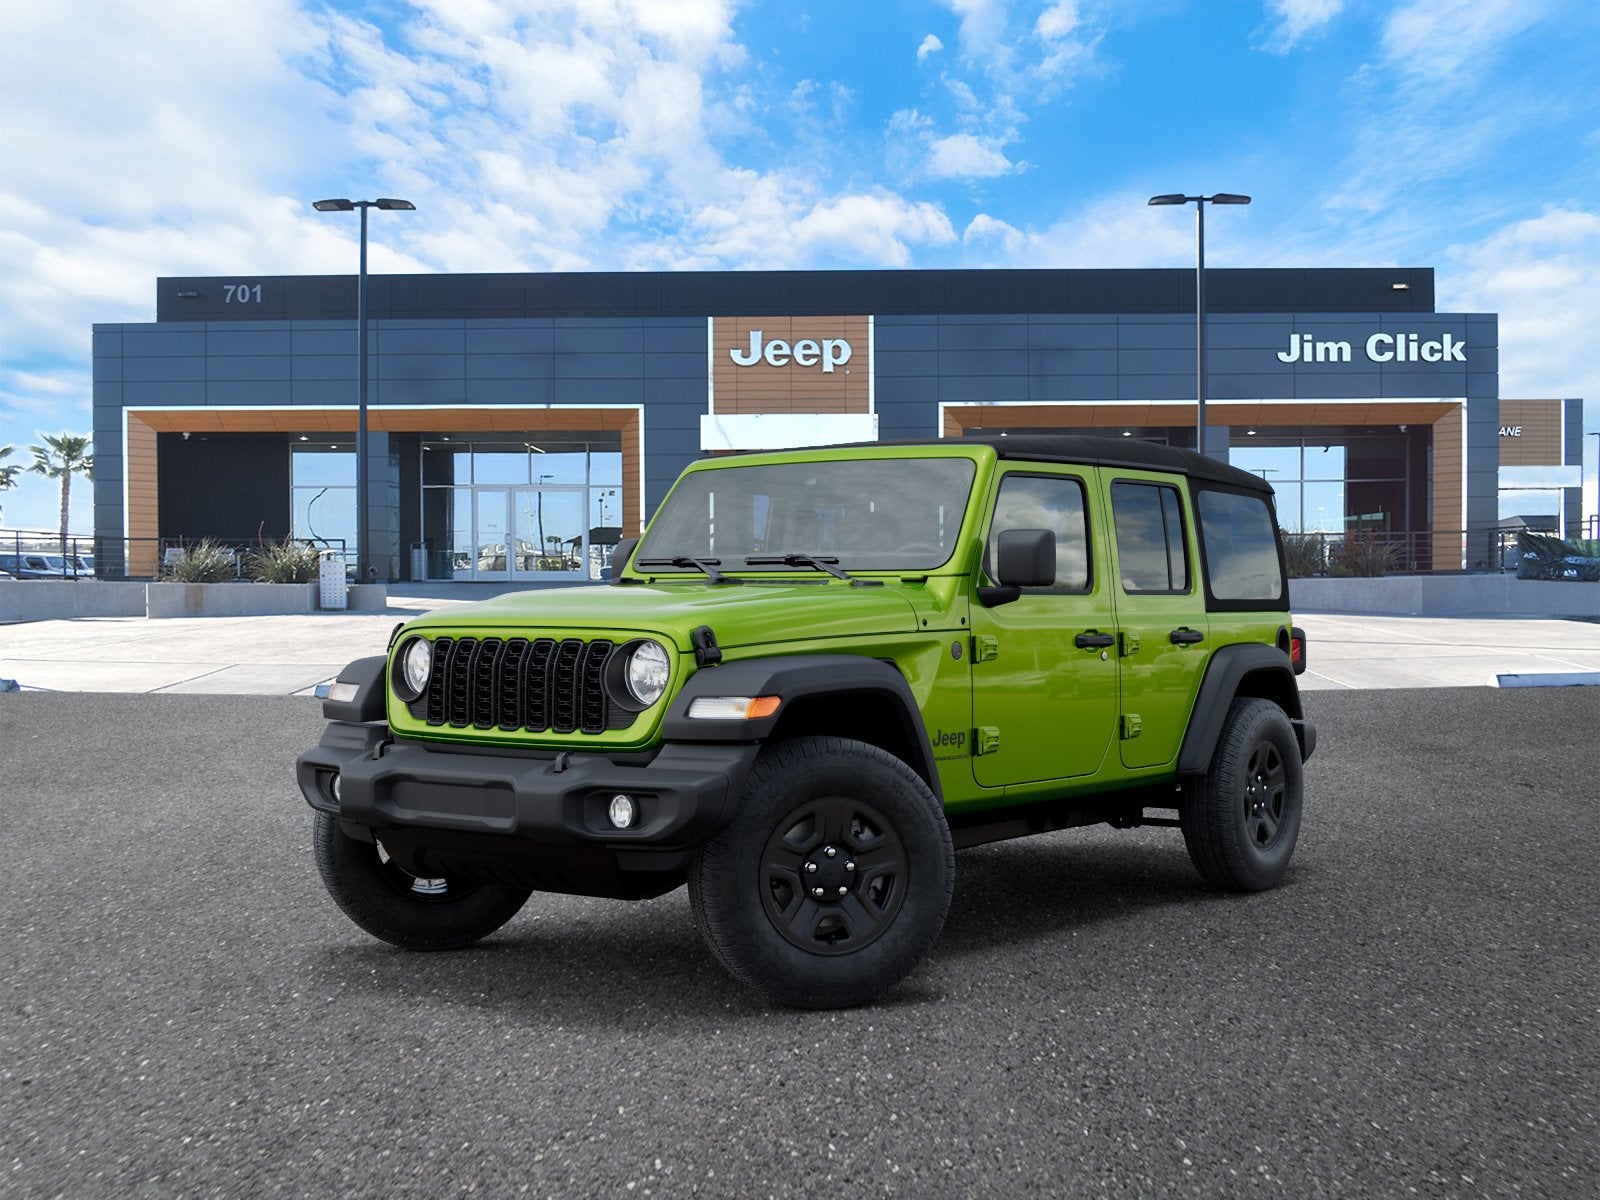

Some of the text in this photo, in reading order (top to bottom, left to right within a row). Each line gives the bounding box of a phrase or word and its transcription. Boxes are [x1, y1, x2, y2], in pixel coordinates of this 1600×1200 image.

[223, 285, 262, 304] 701
[729, 329, 852, 373] Jeep
[1277, 332, 1467, 362] Jim Click
[932, 728, 966, 748] Jeep
